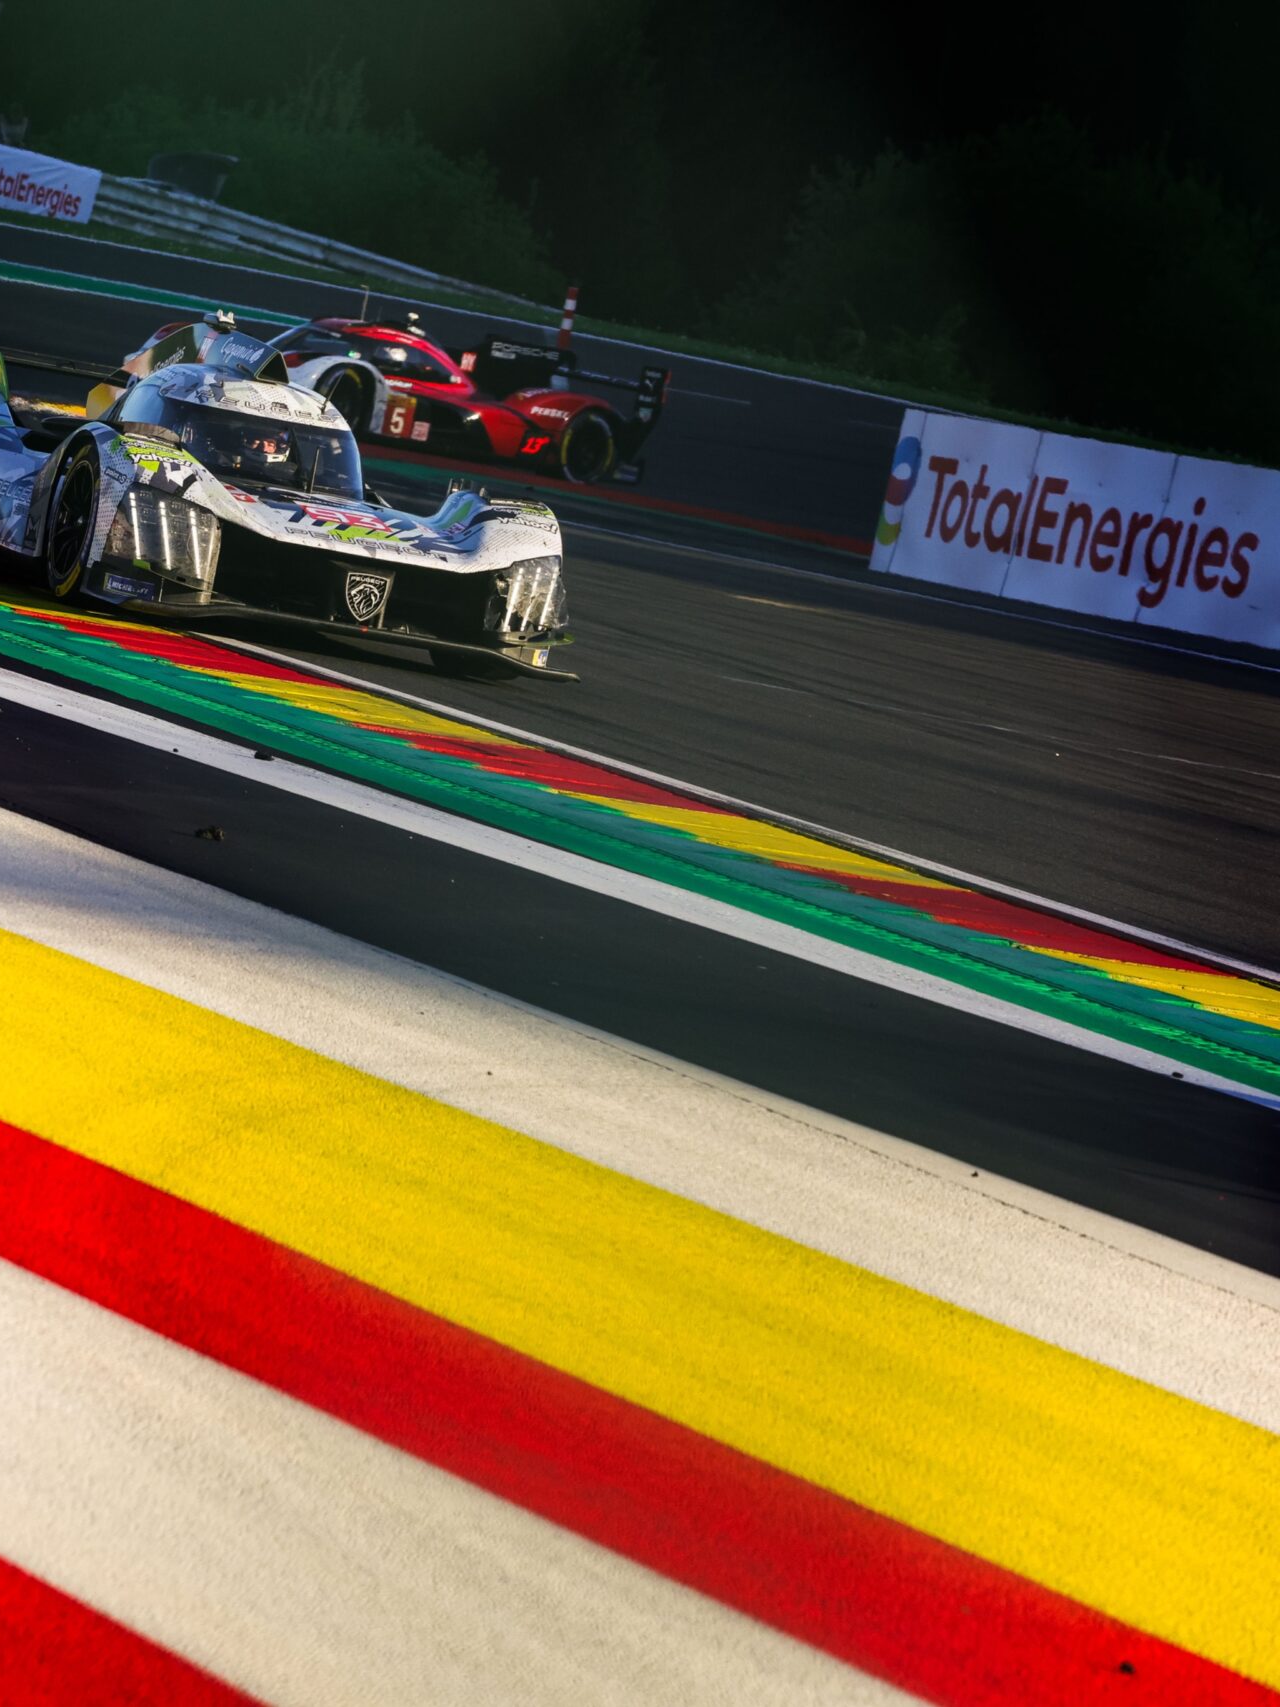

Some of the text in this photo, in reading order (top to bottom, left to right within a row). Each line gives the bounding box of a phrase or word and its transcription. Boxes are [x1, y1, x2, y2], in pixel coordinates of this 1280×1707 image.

[390, 407, 406, 434] 5
[129, 453, 193, 467] yahoo!
[496, 517, 559, 534] yahoo!
[925, 455, 1260, 609] TotalEnergies
